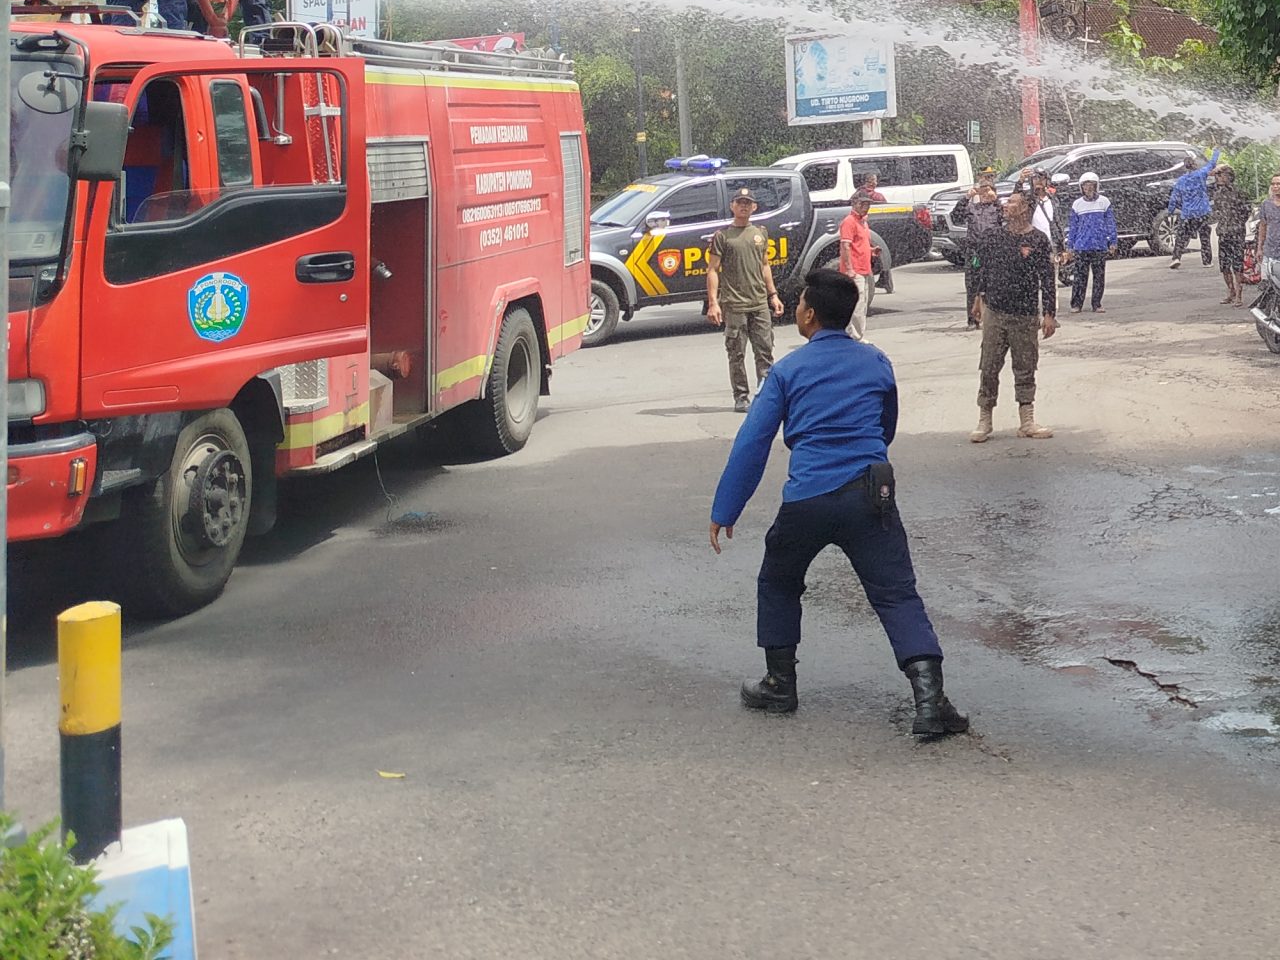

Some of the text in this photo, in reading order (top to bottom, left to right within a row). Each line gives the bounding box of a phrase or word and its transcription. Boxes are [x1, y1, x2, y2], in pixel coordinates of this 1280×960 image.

[475, 170, 506, 195] KABUPATEN
[479, 222, 529, 252] (0352) 461013
